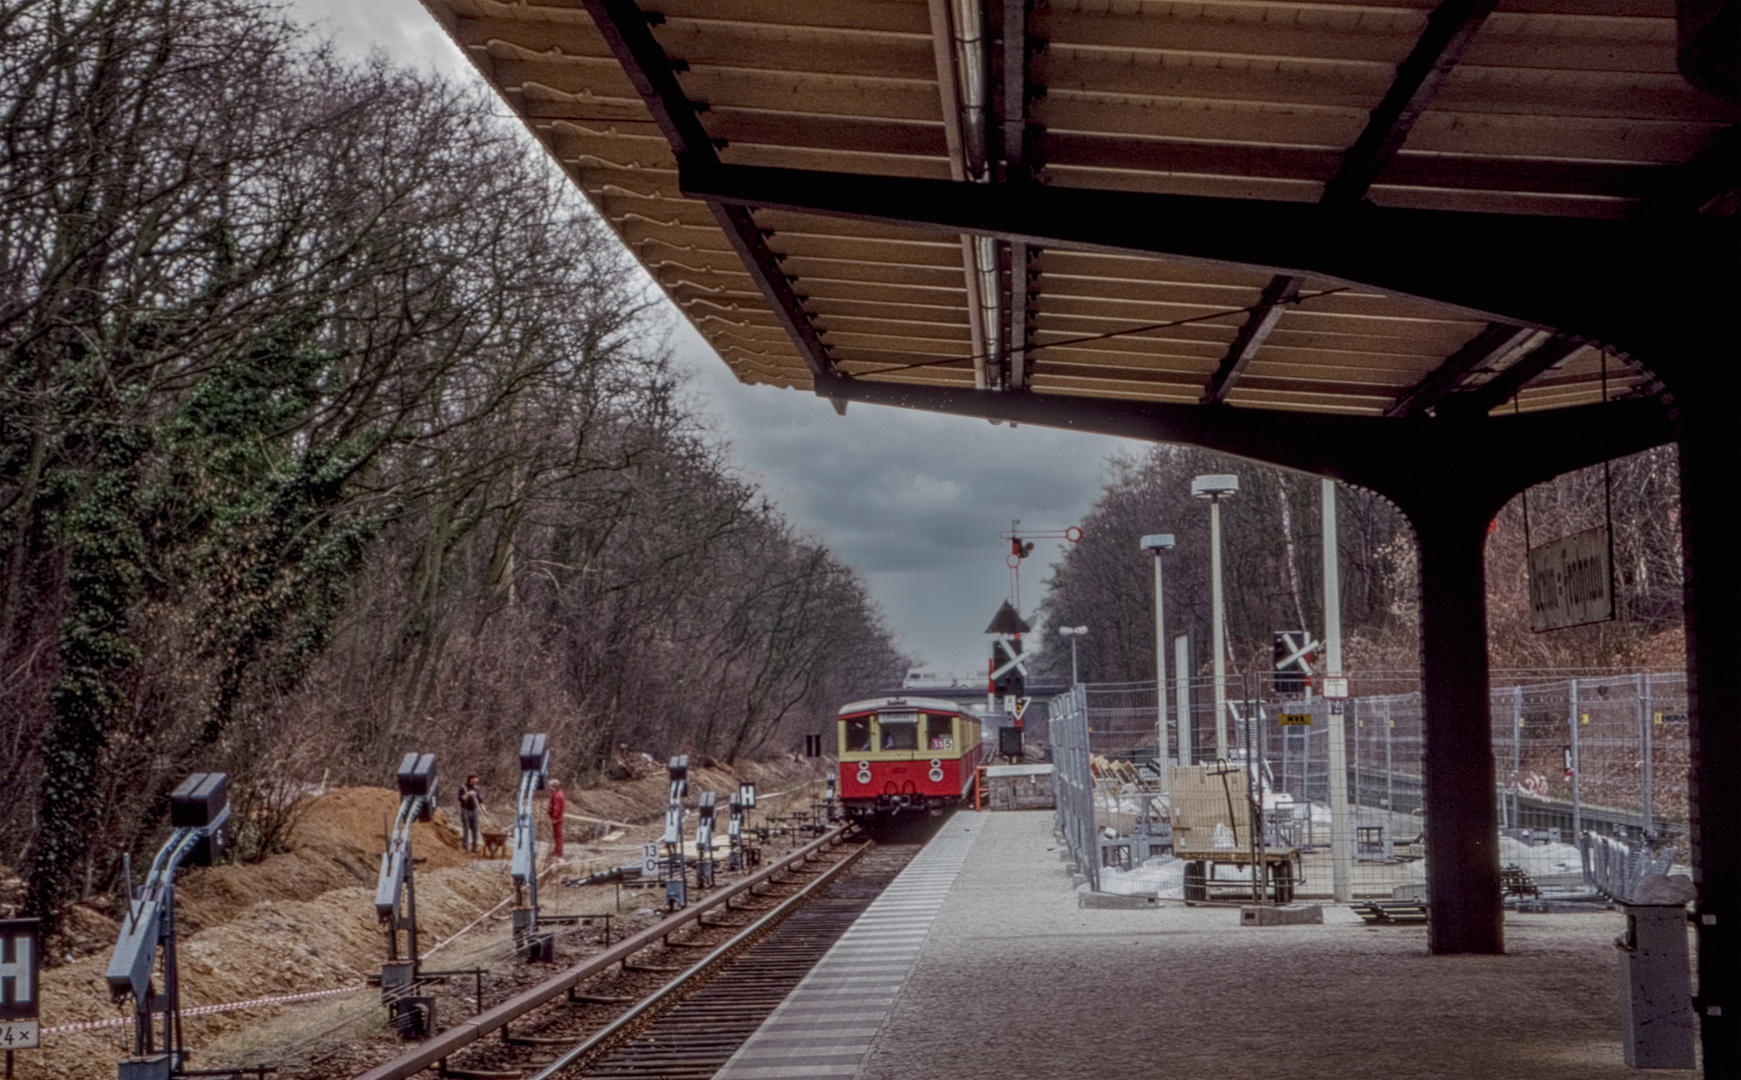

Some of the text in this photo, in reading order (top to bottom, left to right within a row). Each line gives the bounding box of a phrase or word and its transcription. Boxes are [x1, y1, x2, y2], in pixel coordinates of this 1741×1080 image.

[1662, 714, 1688, 722] HERA
[945, 739, 952, 749] 5
[740, 785, 755, 805] H
[644, 845, 657, 857] 13
[0, 937, 31, 1002] H
